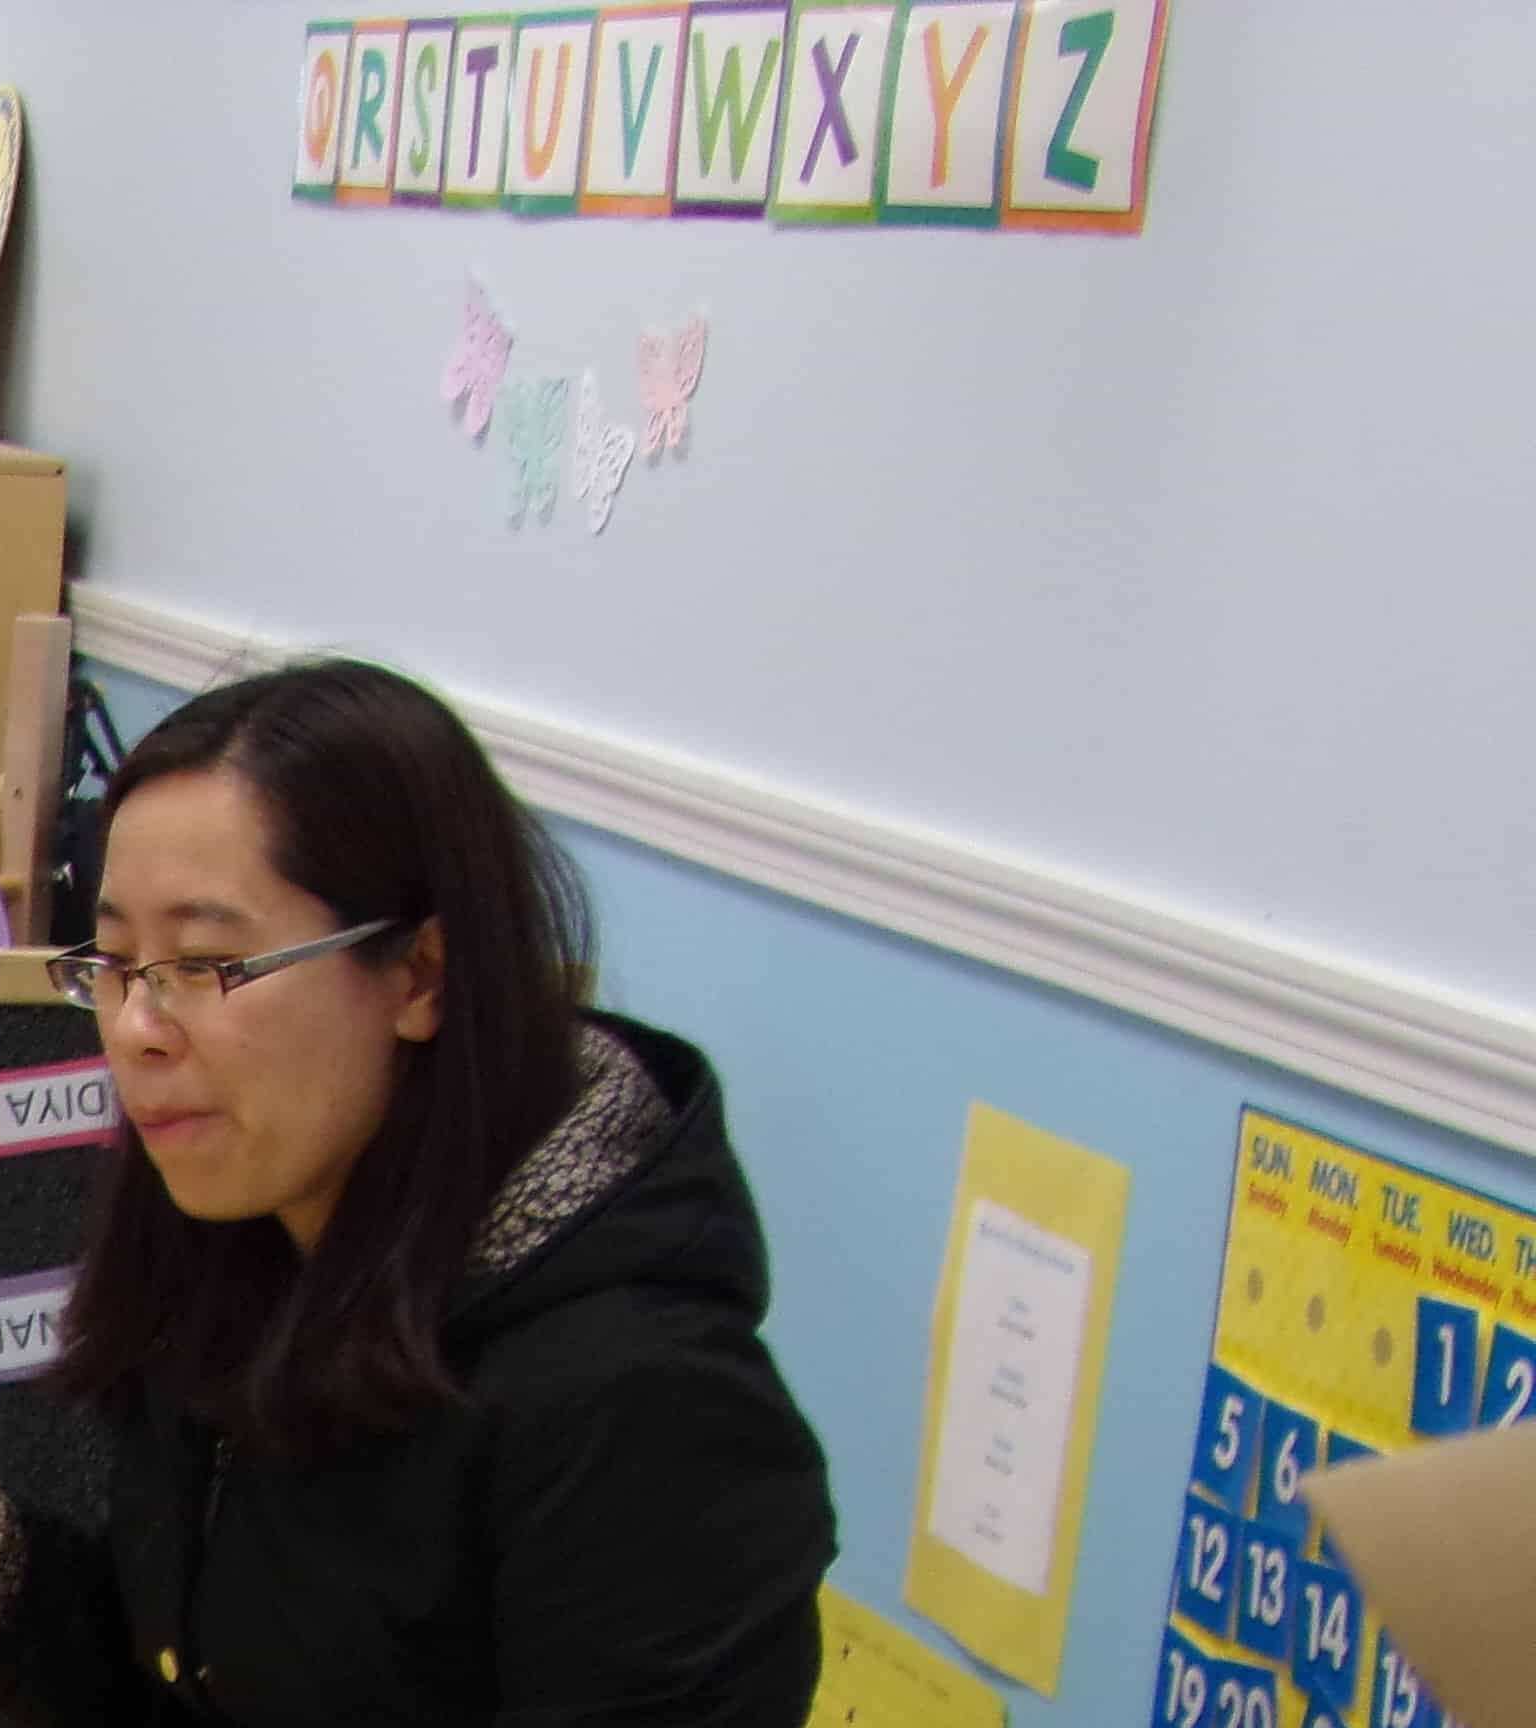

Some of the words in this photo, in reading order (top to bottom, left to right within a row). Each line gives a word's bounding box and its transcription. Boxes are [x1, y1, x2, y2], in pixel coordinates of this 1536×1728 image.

[4, 1080, 106, 1128] DIYA
[1251, 1135, 1294, 1184] SUN.
[1308, 1158, 1359, 1212] MON.
[1380, 1182, 1423, 1234] TUE.
[1446, 1209, 1498, 1267] WED.
[1438, 1323, 1458, 1407] 1
[1497, 1359, 1533, 1432] 2
[1213, 1394, 1244, 1470] 5
[1274, 1429, 1298, 1504] 6
[1189, 1513, 1228, 1603] 12
[1247, 1541, 1288, 1626] 13
[1304, 1582, 1349, 1671] 14
